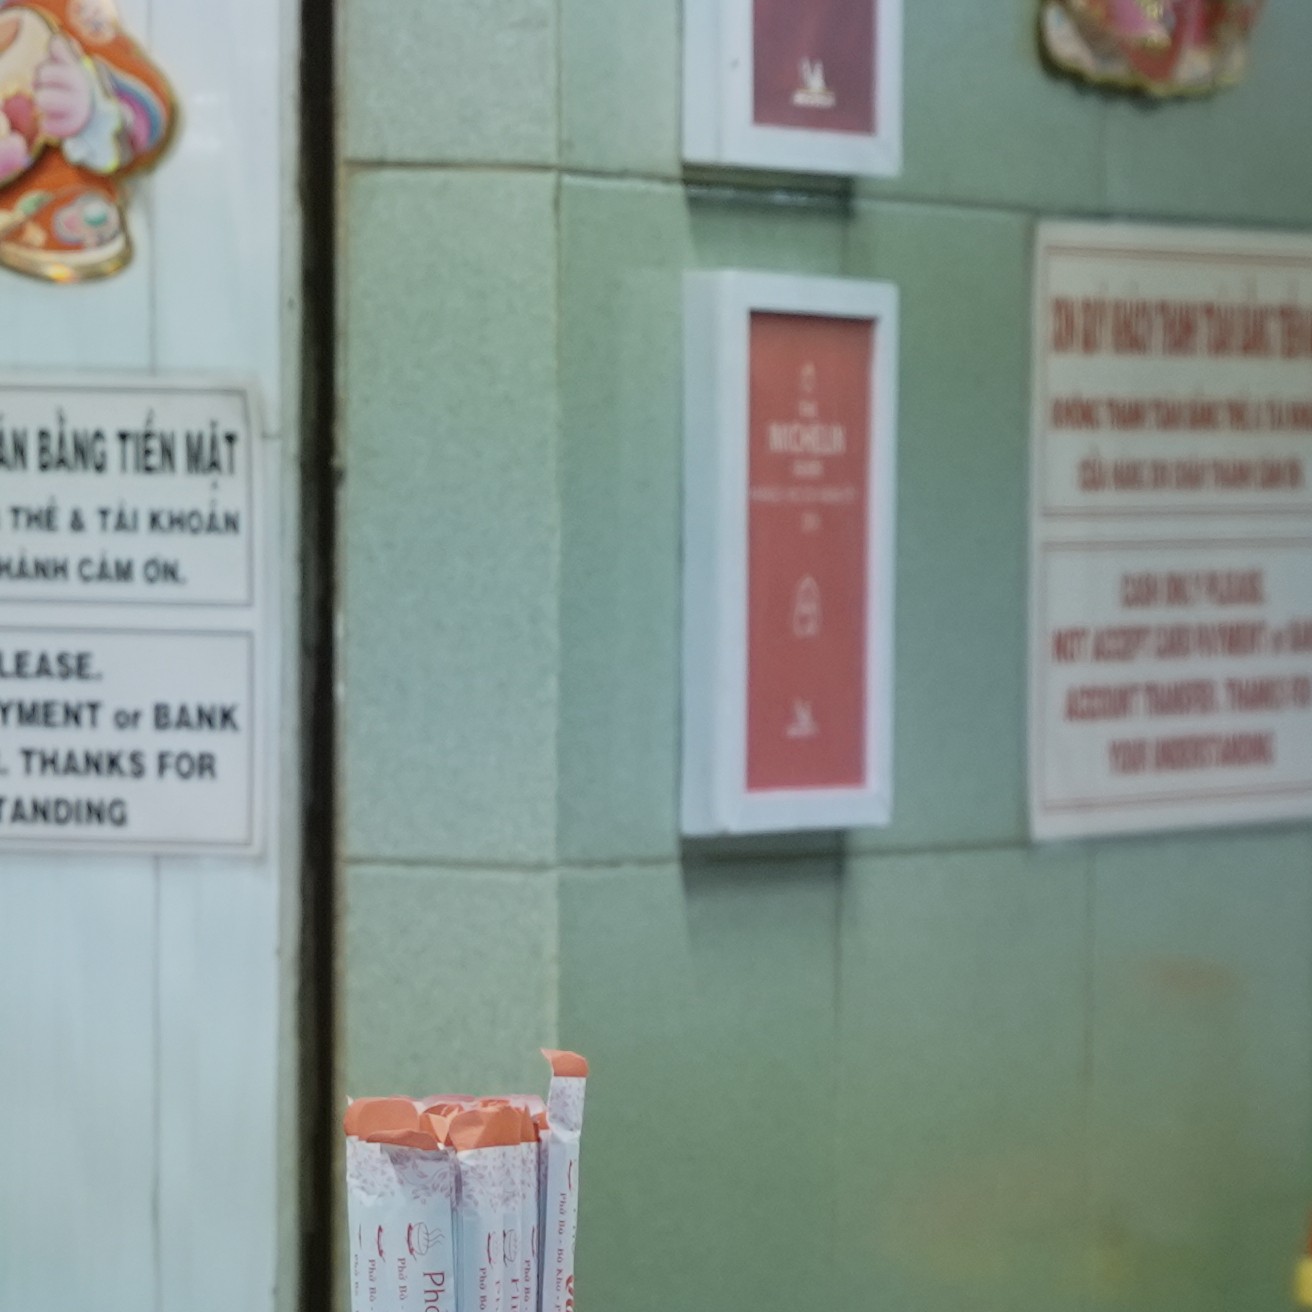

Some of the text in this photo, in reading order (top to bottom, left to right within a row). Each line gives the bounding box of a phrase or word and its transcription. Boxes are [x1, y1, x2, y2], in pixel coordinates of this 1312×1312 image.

[70, 507, 85, 532] &
[113, 708, 142, 730] or
[154, 702, 241, 732] BANK
[21, 748, 145, 779] THANKS
[158, 750, 217, 780] FOR
